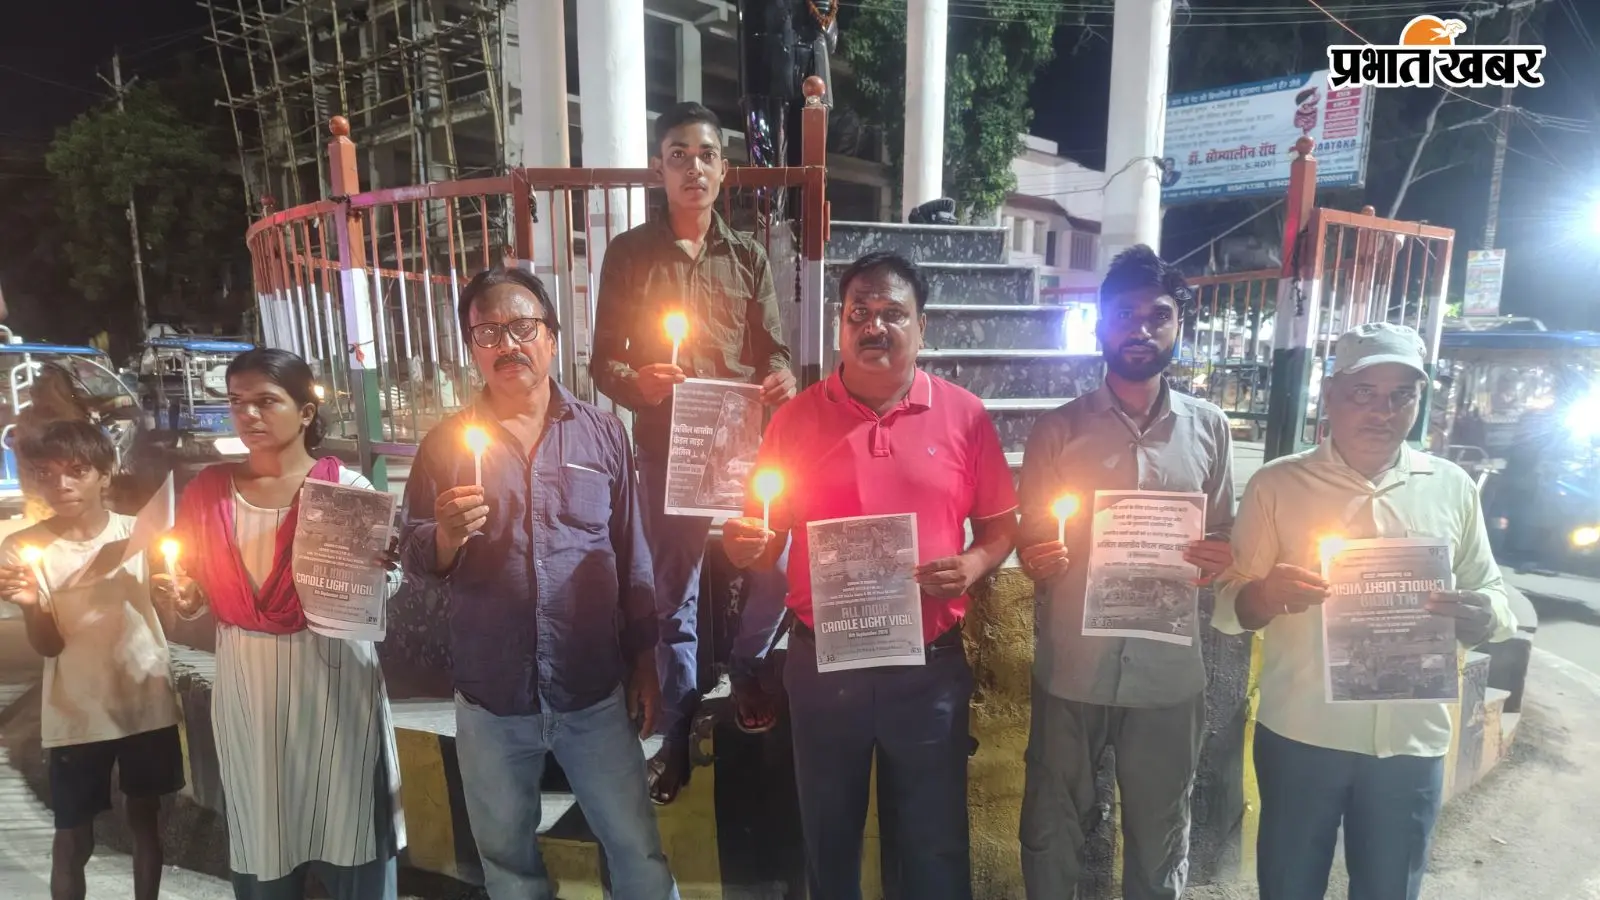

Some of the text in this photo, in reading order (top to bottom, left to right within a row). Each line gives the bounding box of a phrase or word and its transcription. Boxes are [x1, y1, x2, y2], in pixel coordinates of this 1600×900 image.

[296, 573, 374, 596] CANDLE LIGHT VIGIL
[1364, 581, 1397, 594] LIGHT
[1400, 579, 1445, 593] CANDLE
[842, 603, 890, 618] ALL INDIA
[821, 614, 913, 633] CANDLE LIGHT VIGIL
